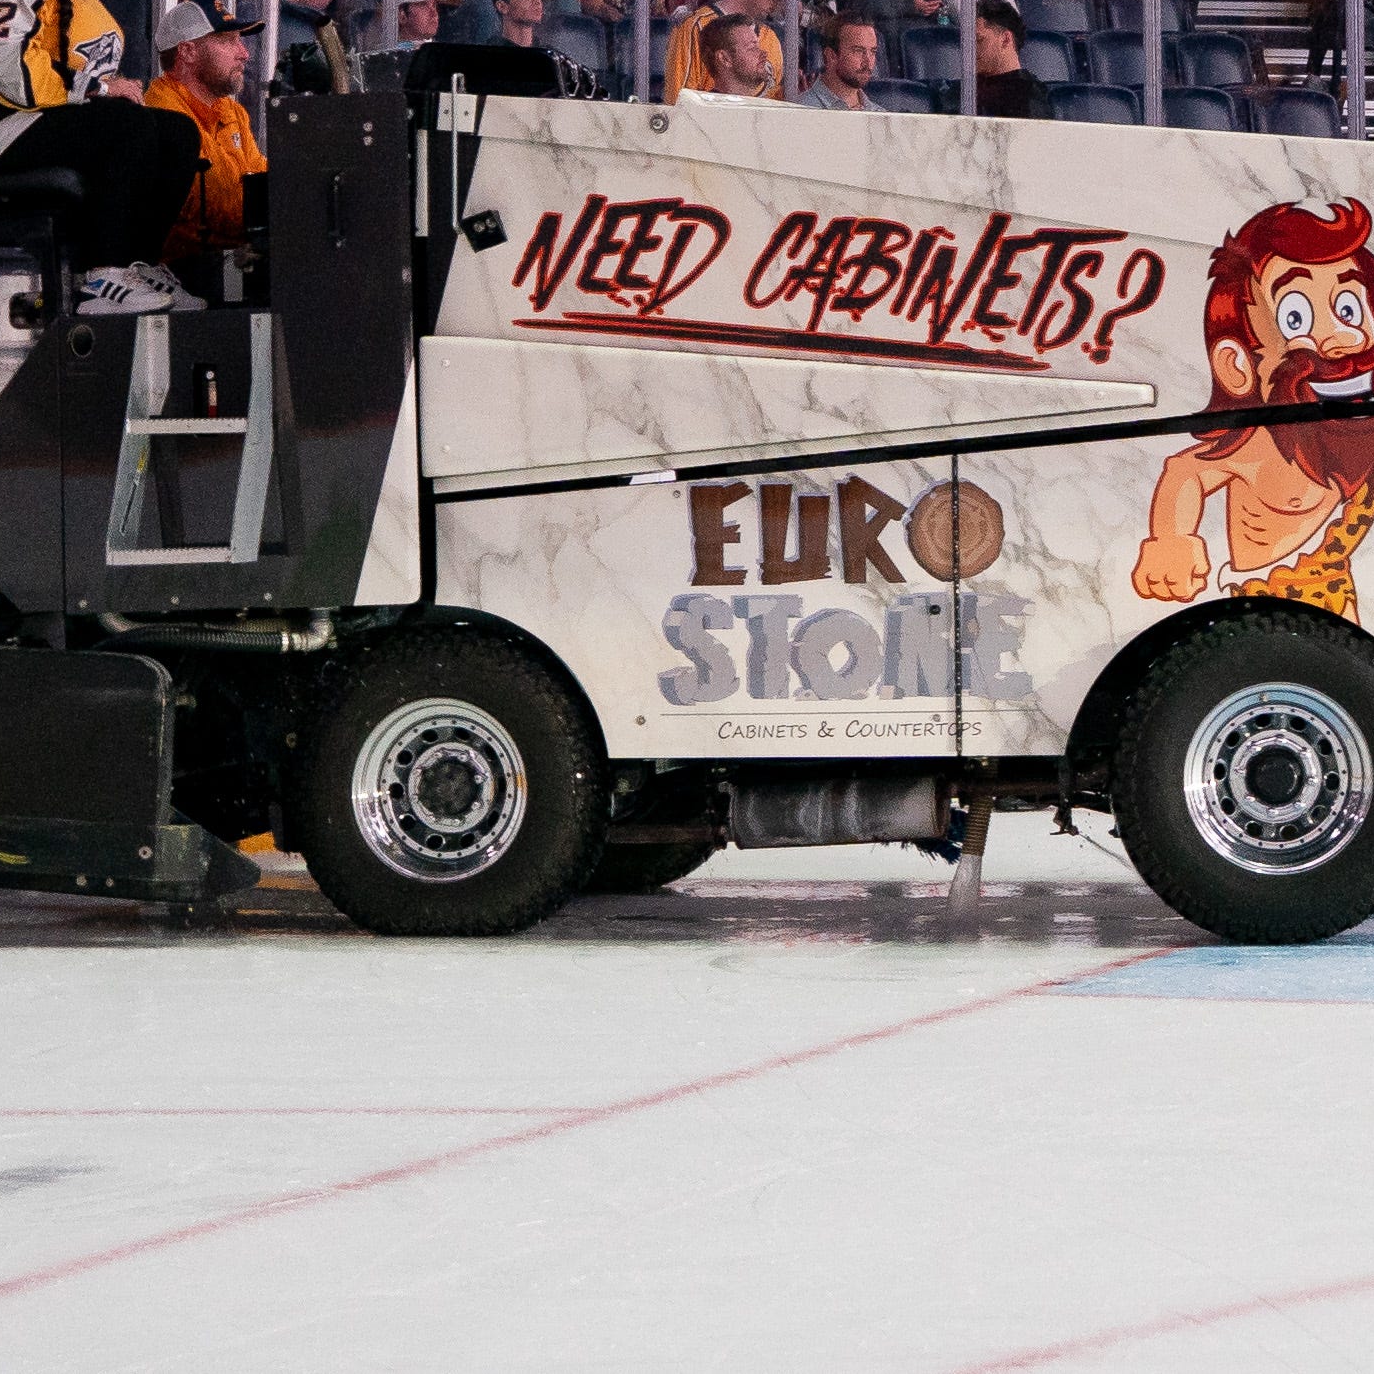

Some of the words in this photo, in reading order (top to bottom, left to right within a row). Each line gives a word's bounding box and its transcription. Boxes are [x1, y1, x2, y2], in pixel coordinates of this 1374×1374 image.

[511, 192, 733, 318] NEED
[742, 212, 1166, 365] CABINETS?
[686, 474, 1006, 587] EURO
[656, 592, 1035, 706] STONE
[817, 719, 835, 740] &
